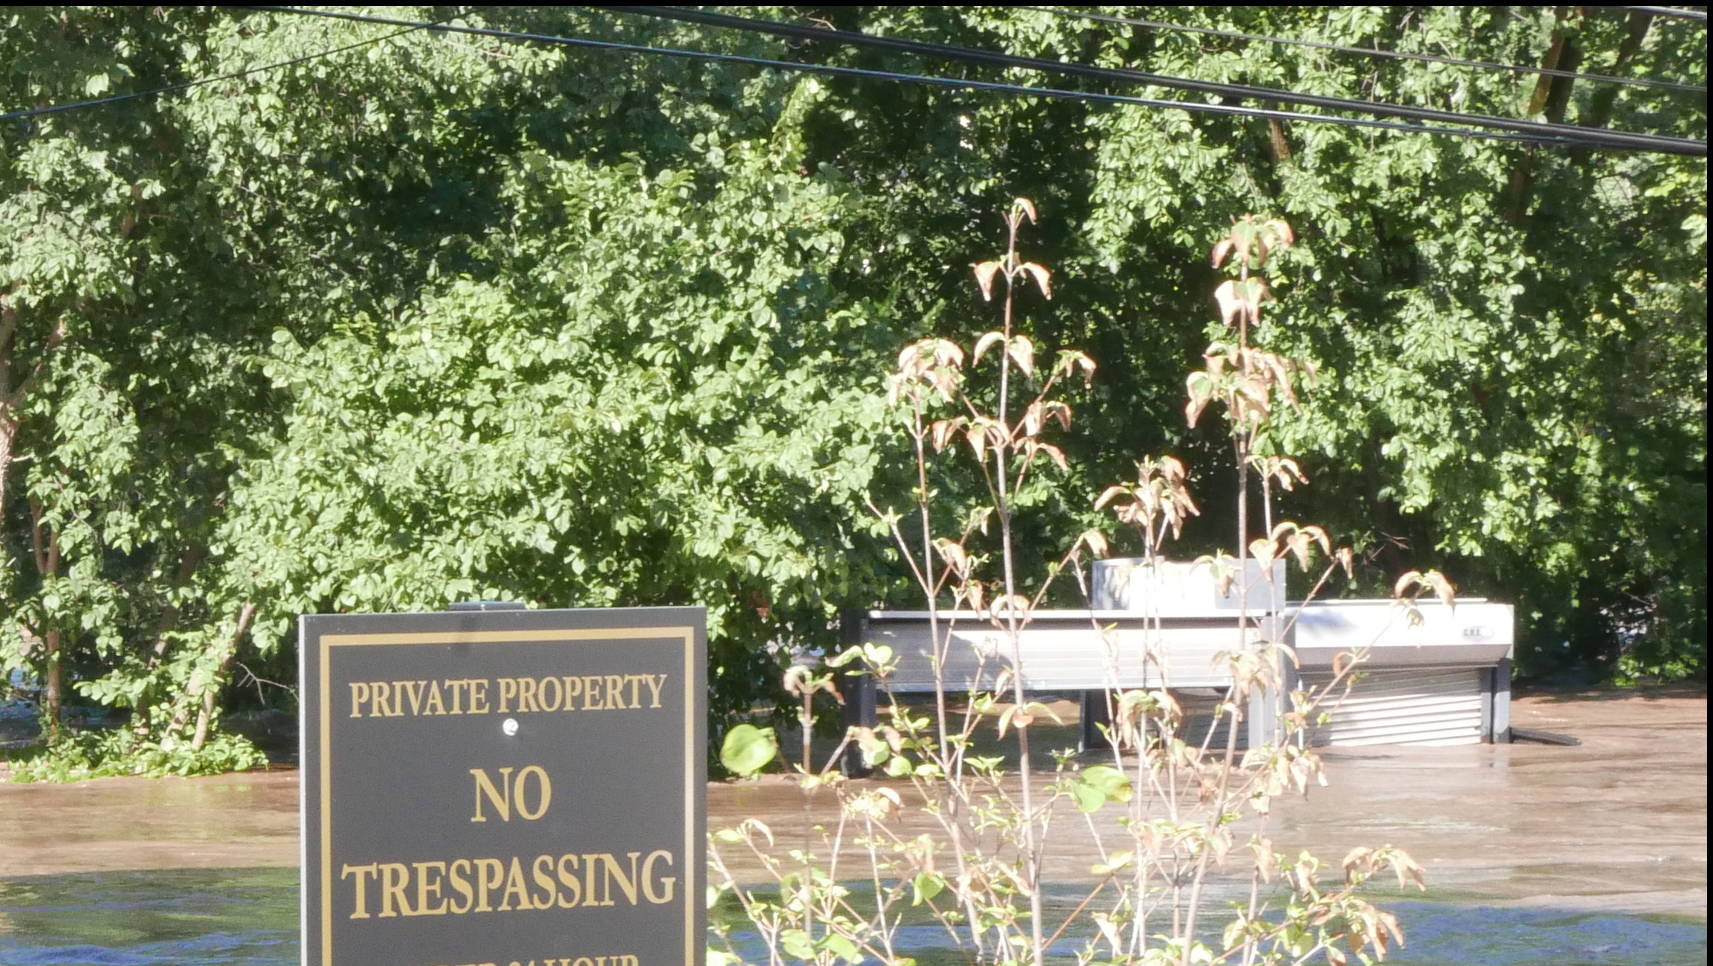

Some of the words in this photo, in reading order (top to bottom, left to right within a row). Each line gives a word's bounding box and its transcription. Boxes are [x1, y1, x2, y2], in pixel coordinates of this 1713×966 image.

[349, 678, 489, 718] PRIVATE
[497, 673, 667, 713] PROPERTY
[470, 764, 552, 823] NO
[341, 849, 676, 920] TRESPASSING
